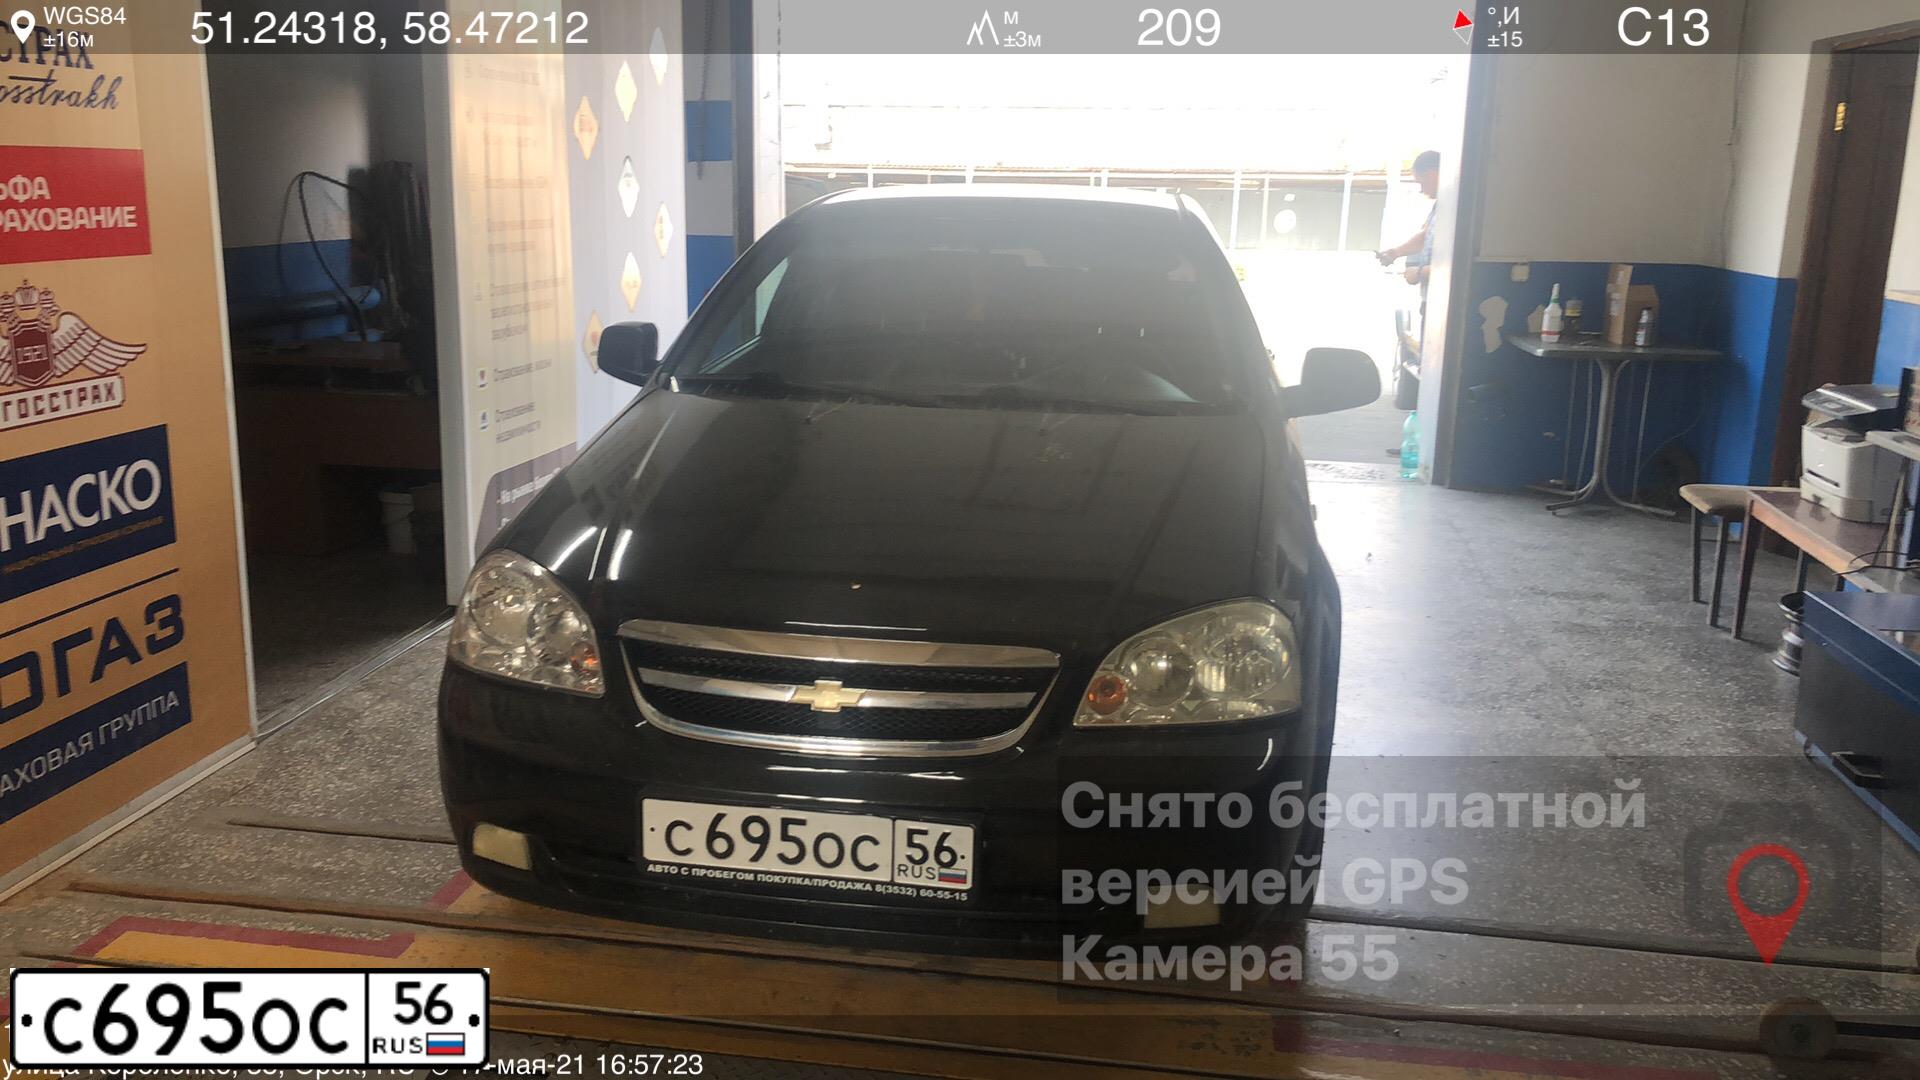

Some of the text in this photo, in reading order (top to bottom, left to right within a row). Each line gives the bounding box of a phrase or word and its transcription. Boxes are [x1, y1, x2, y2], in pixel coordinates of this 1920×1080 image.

[0, 206, 137, 233] АХОВАНИЕ
[0, 458, 162, 551] НАСКО
[98, 690, 180, 745] ГРУППА
[905, 828, 959, 869] 56
[647, 864, 968, 901] АВТО С ПРОБЕГОМ ПОКУПКА/ПРОДАЖА 8(3532) 60-55-15
[897, 863, 937, 880] RUS
